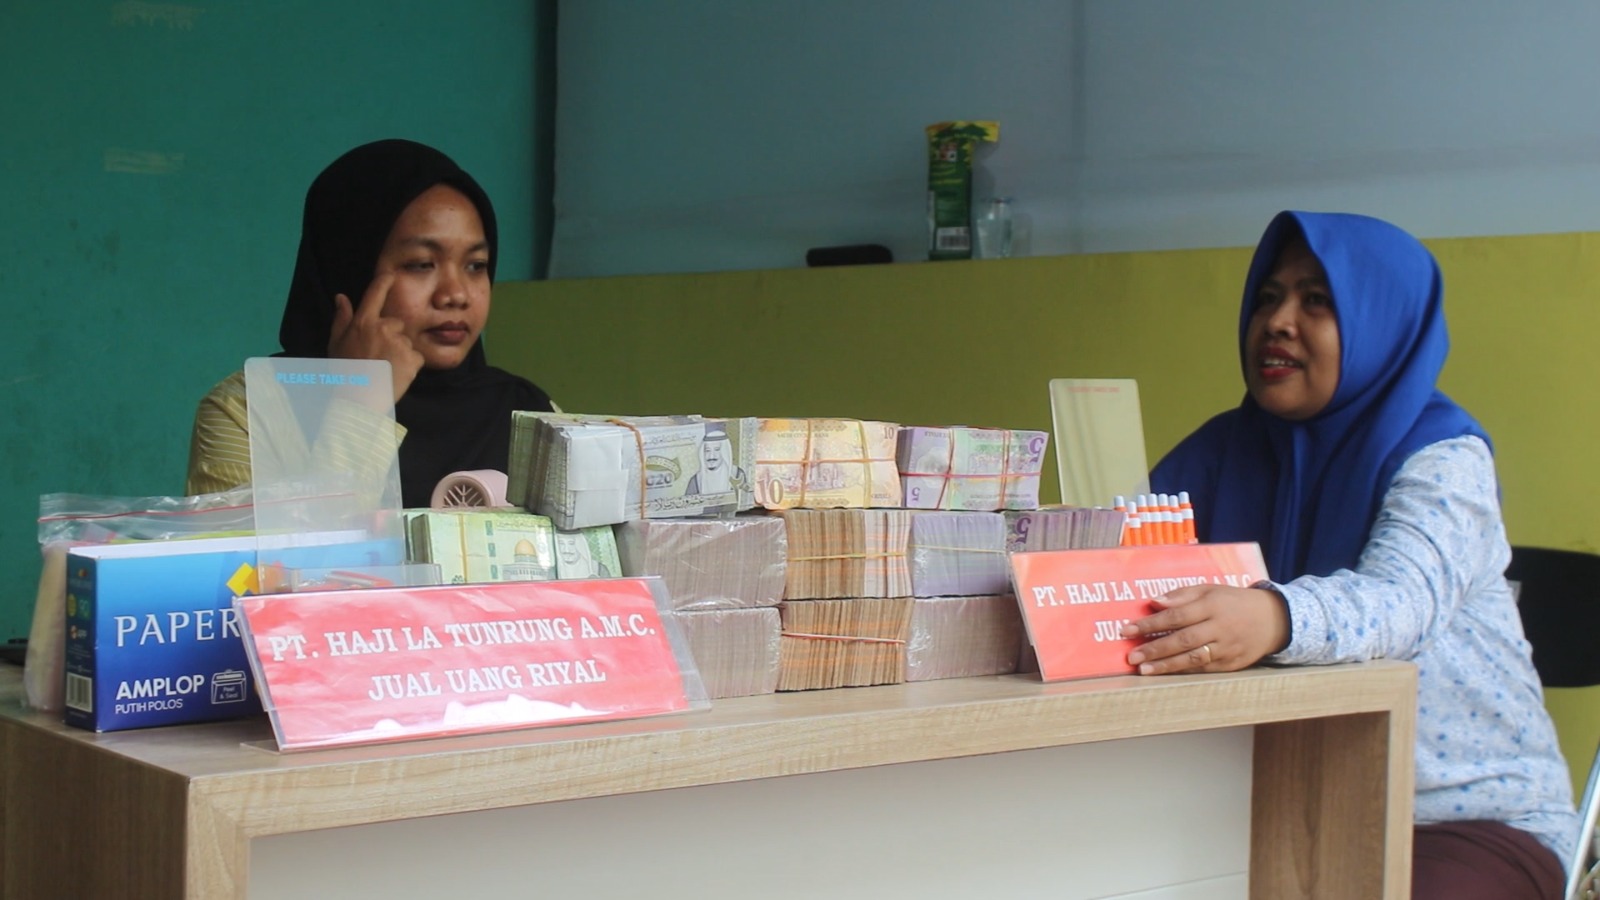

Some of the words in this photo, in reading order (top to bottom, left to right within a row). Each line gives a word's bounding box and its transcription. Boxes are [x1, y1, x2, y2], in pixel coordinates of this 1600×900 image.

[276, 372, 317, 384] PLEASE
[319, 373, 345, 385] TAKE
[884, 427, 895, 439] 10
[1032, 586, 1064, 607] PT.
[1065, 582, 1110, 604] HAJI
[1110, 581, 1136, 601] LA
[113, 608, 241, 647] PAPER
[268, 634, 319, 661] PT.
[324, 628, 399, 657] HAJI
[402, 626, 442, 651] LA
[445, 616, 574, 648] TUNRUNG
[581, 614, 655, 639] A.M.C.
[1094, 619, 1130, 642] JUA
[116, 674, 205, 700] AMPLOP
[368, 672, 442, 701] JUAL
[445, 665, 523, 694] UANG
[526, 659, 606, 687] RIYAL
[115, 702, 147, 714] PUTIH
[148, 698, 183, 711] POLOS
